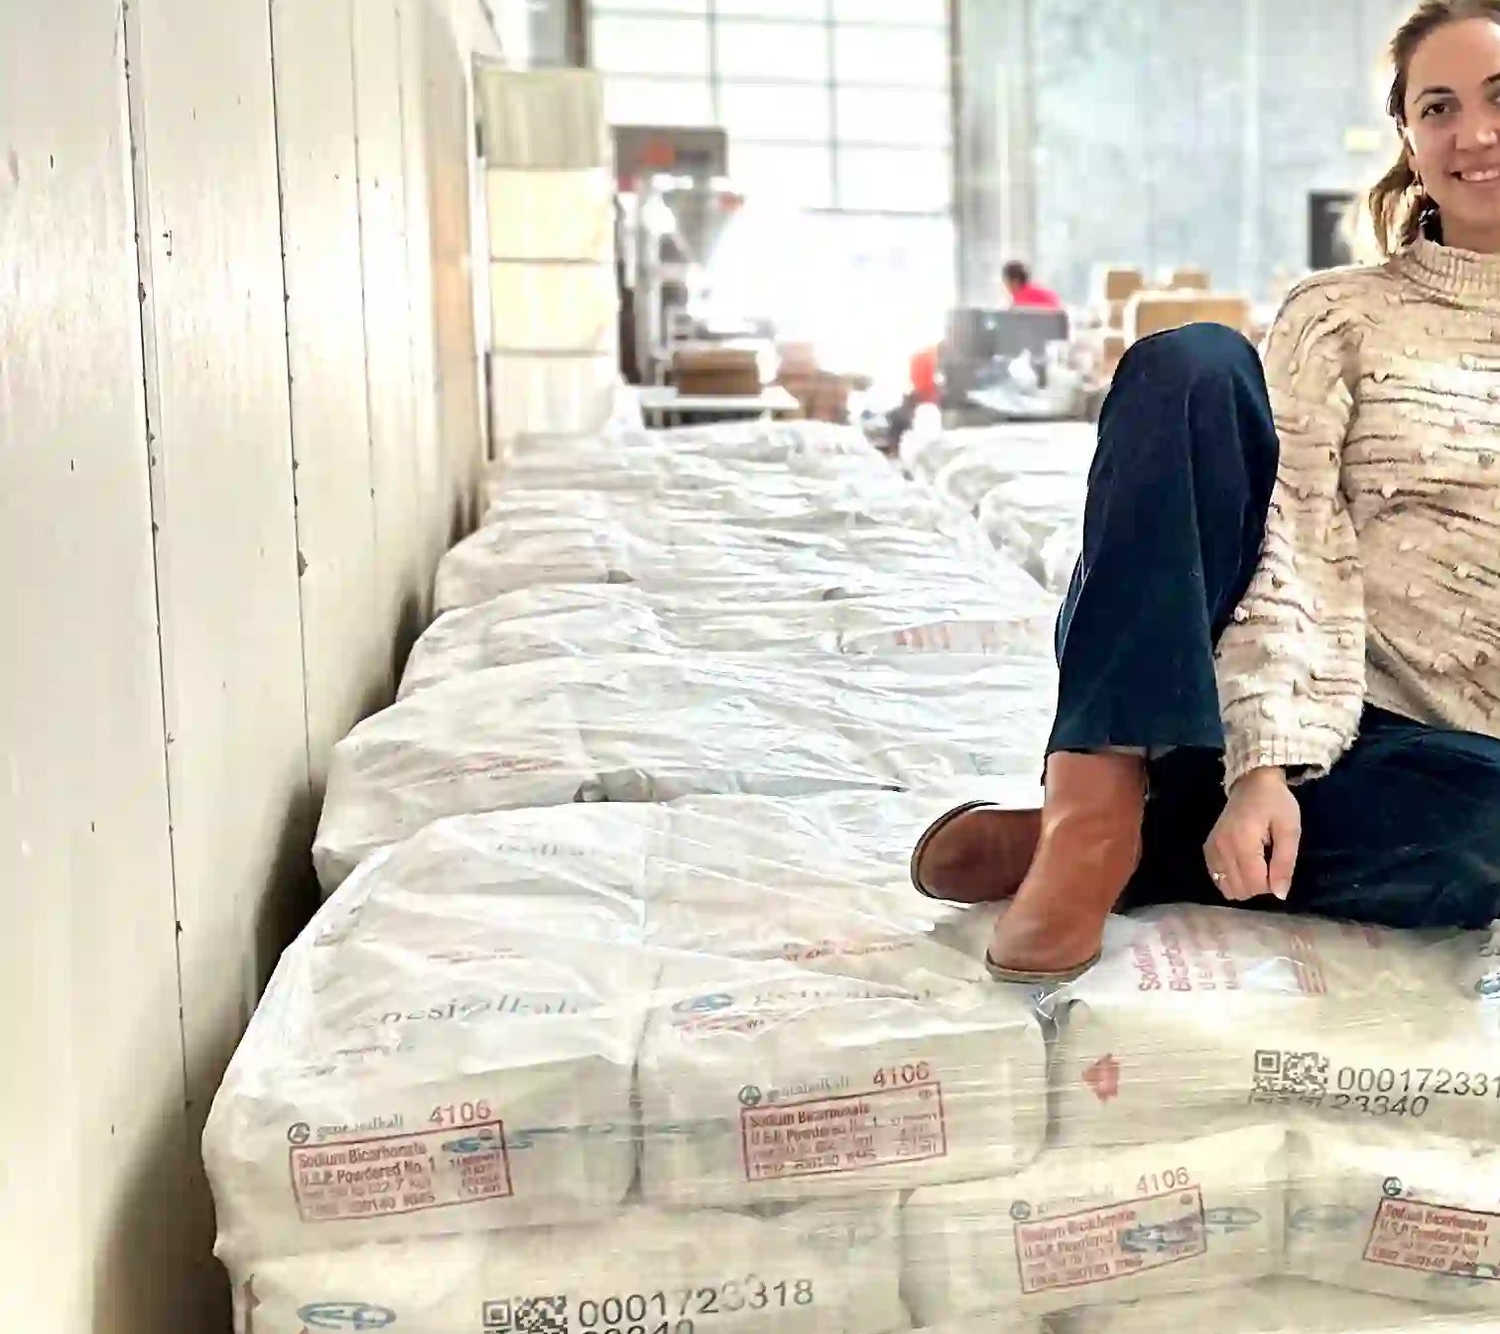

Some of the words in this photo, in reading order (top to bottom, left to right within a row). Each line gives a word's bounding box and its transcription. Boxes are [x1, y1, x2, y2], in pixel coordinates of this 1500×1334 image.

[873, 1062, 929, 1088] 4106
[429, 1099, 491, 1123] 4106
[1330, 1094, 1429, 1117] 23340
[1136, 1167, 1189, 1194] 4106
[578, 1274, 814, 1328] 0001723318
